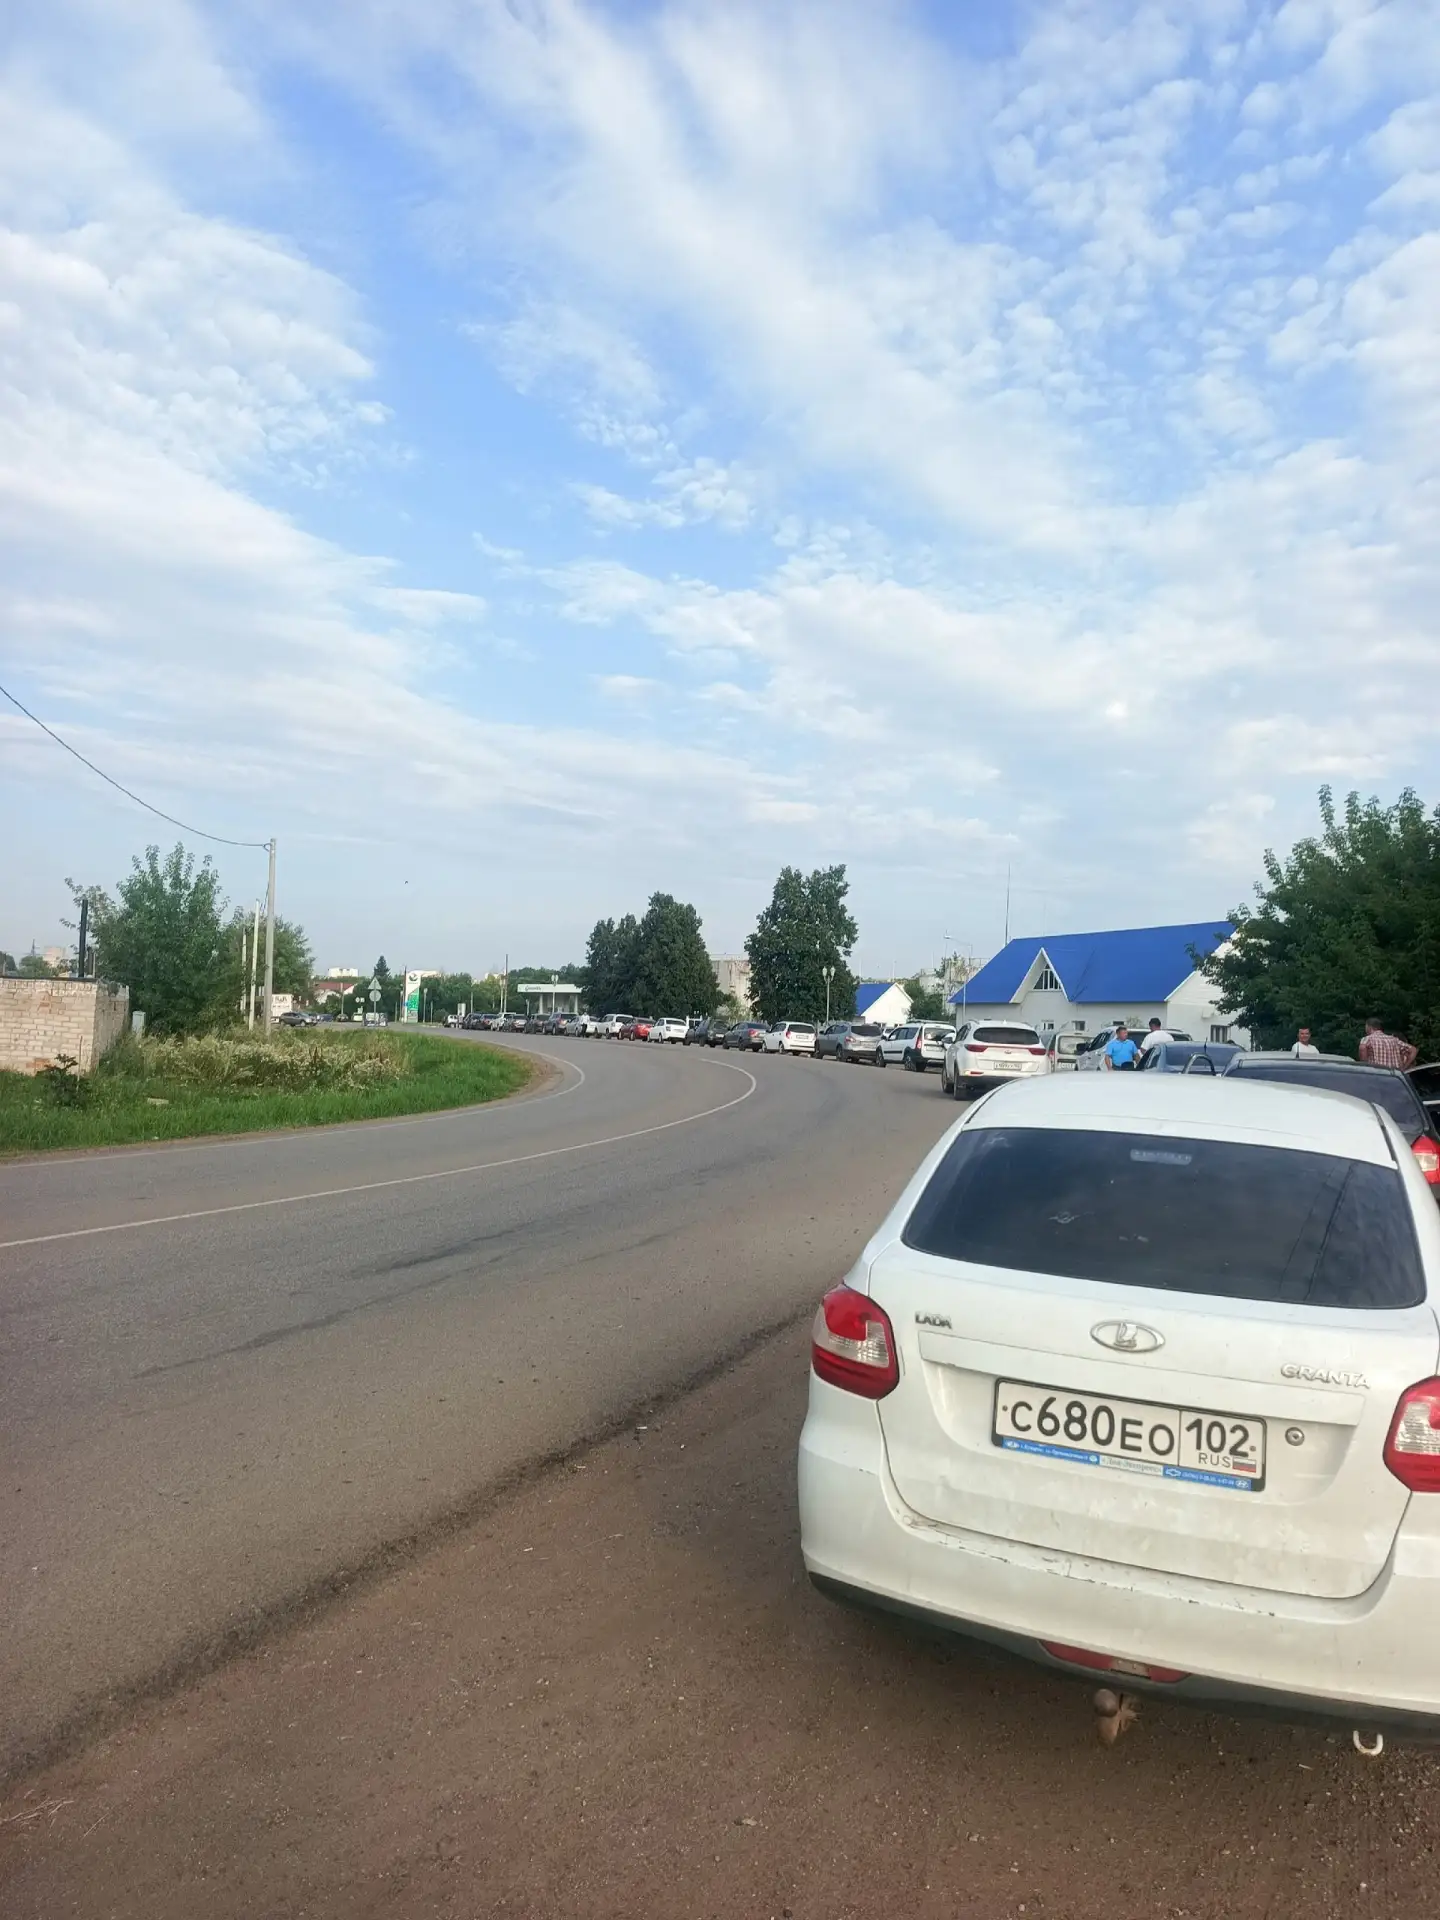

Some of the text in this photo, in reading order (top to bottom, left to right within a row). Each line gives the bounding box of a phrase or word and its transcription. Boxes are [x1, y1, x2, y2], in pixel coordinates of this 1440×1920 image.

[915, 1311, 952, 1330] LADA
[1281, 1363, 1370, 1389] GRANTA
[1010, 1397, 1249, 1457] С680ЕО 102
[1199, 1452, 1231, 1468] RUS
